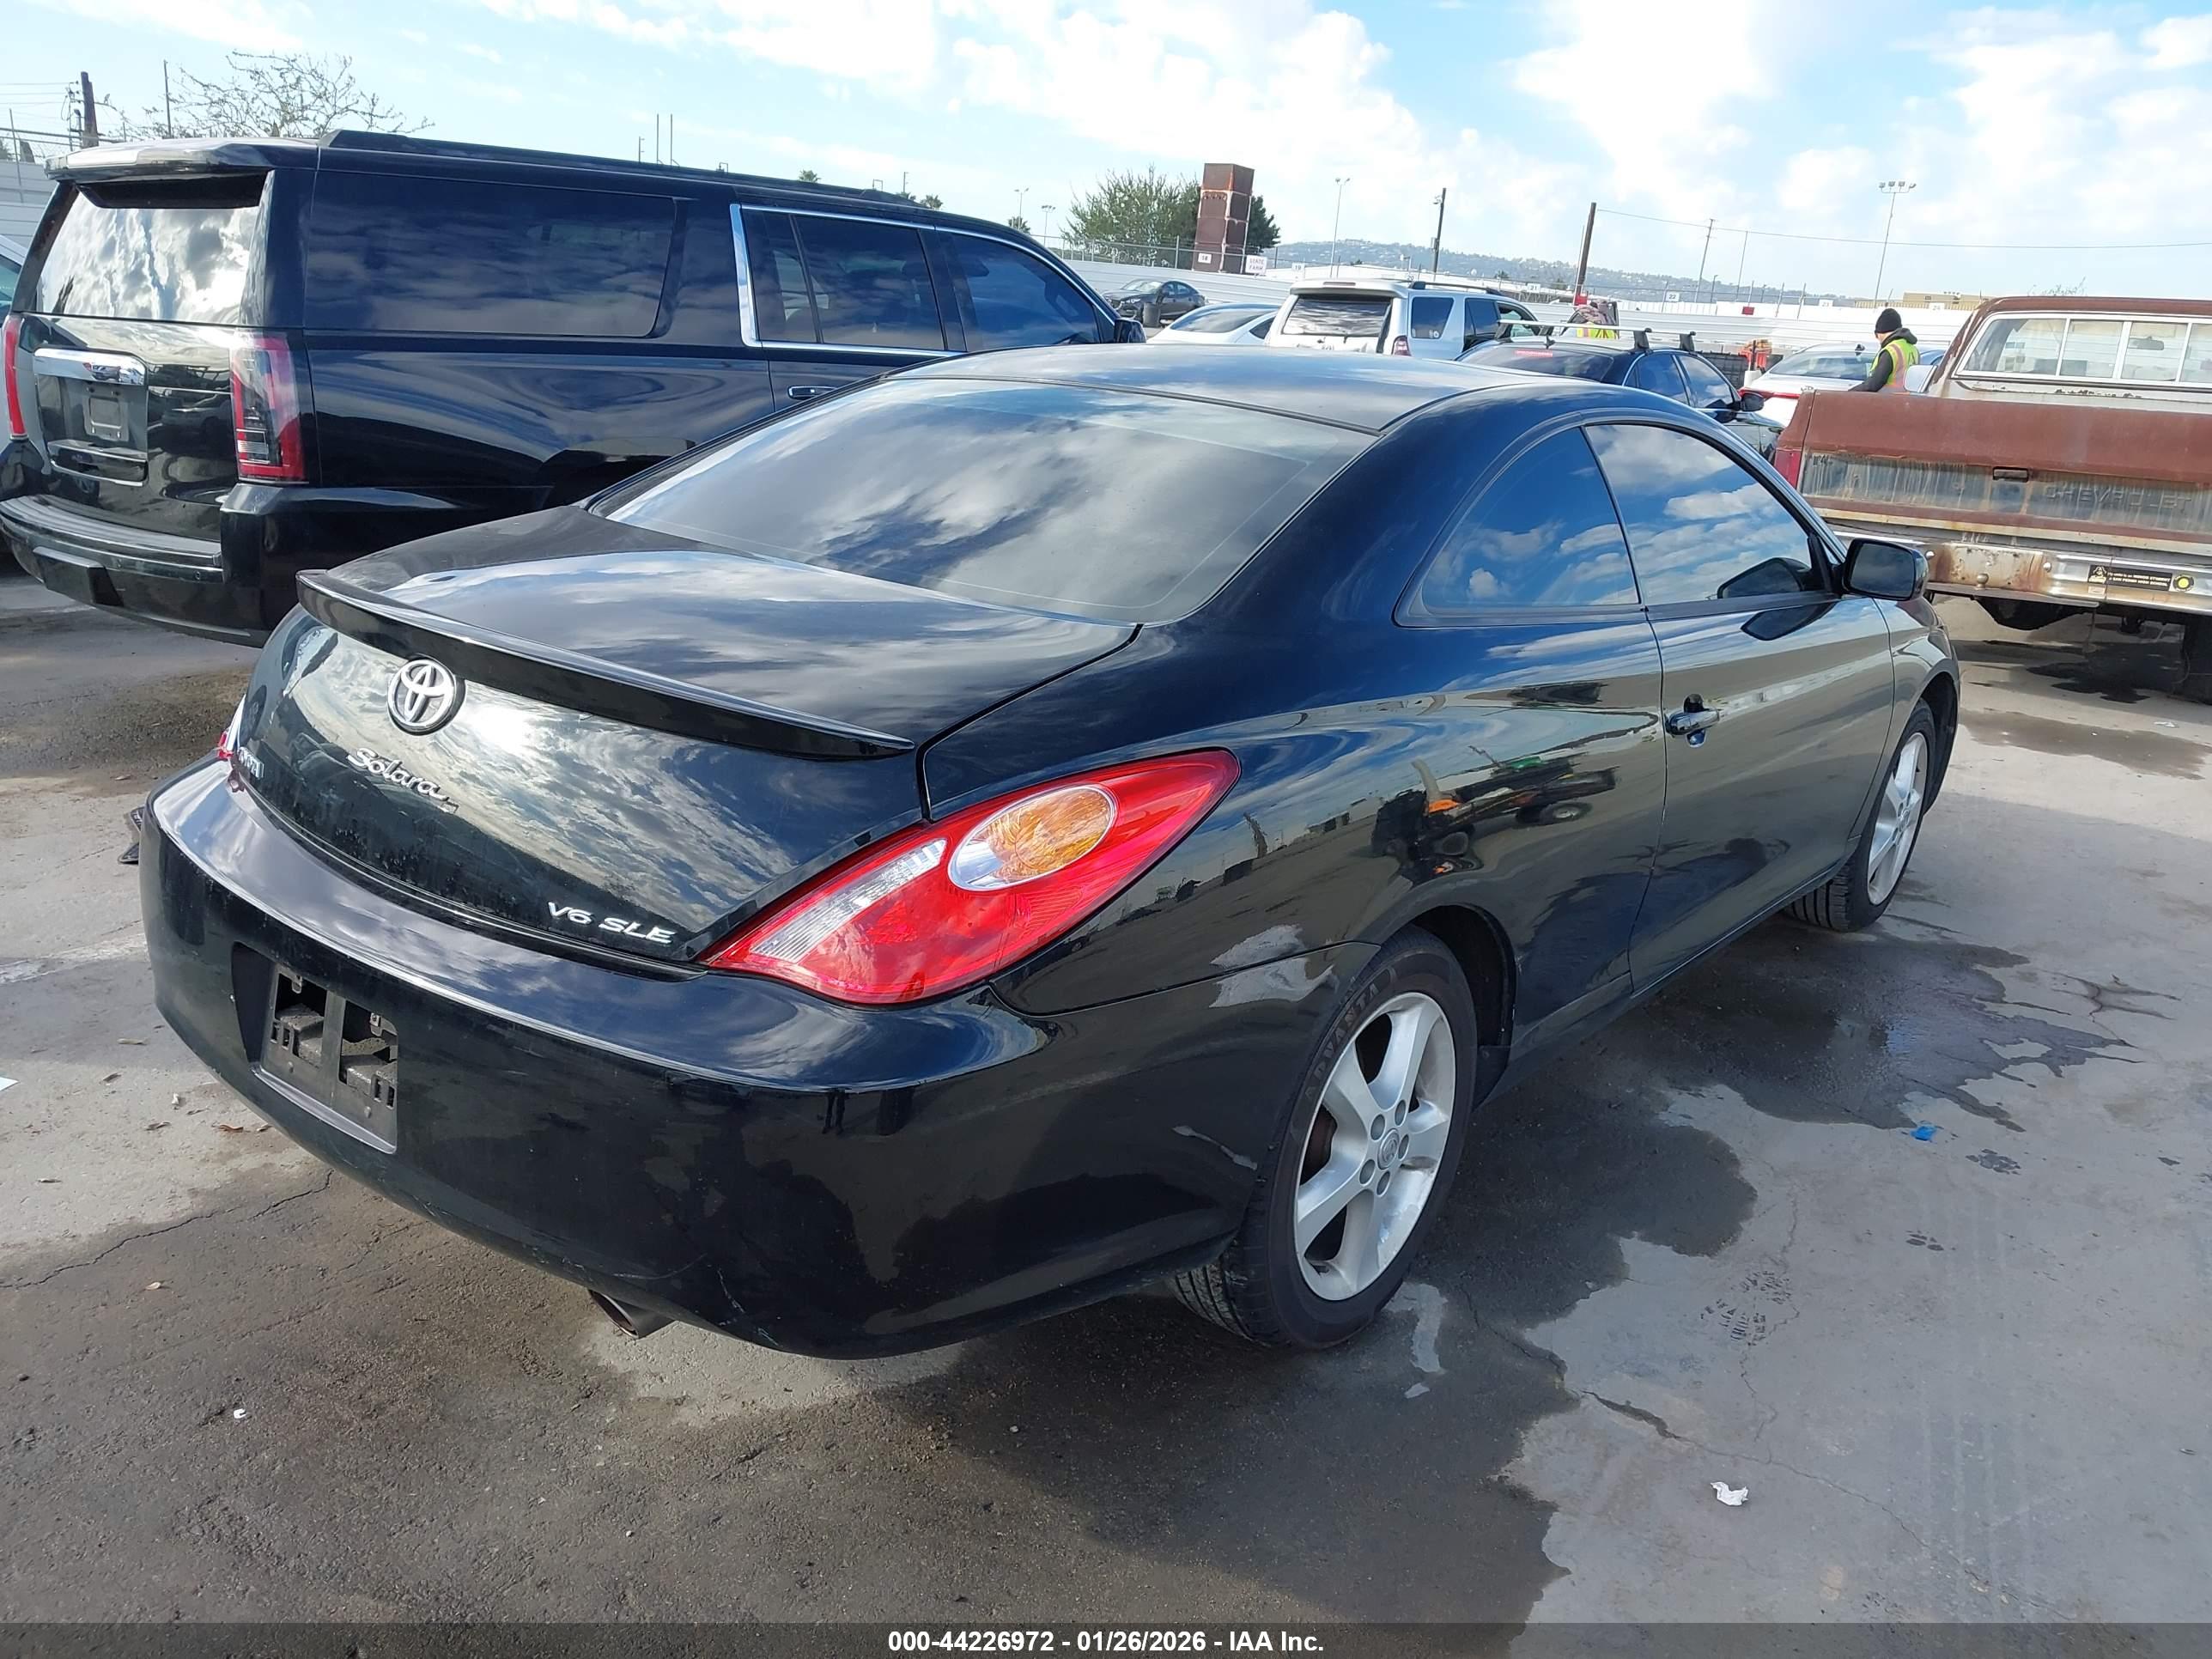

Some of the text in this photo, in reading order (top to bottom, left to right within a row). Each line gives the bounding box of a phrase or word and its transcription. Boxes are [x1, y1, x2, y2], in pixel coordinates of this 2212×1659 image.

[346, 747, 450, 802] Solara
[548, 902, 678, 945] V6 SLE
